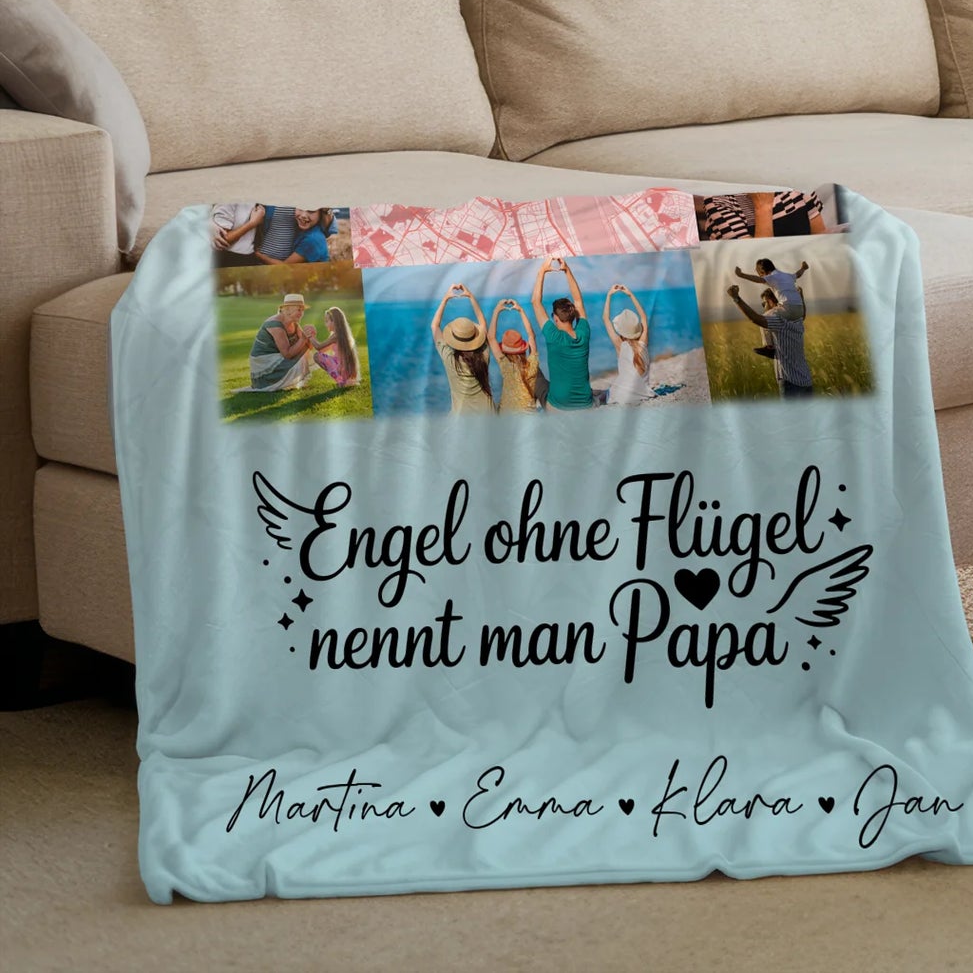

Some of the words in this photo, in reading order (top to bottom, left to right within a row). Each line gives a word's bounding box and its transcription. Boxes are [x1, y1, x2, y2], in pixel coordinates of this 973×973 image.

[300, 479, 472, 608] Engel
[485, 478, 620, 565] ohne
[616, 464, 825, 599] Flügel
[309, 598, 466, 671] nennt
[479, 621, 607, 668] man
[609, 578, 789, 709] Papa
[225, 767, 416, 833] Martina
[462, 765, 604, 830] Emma
[651, 755, 804, 838] Klara
[852, 764, 964, 849] Jan
